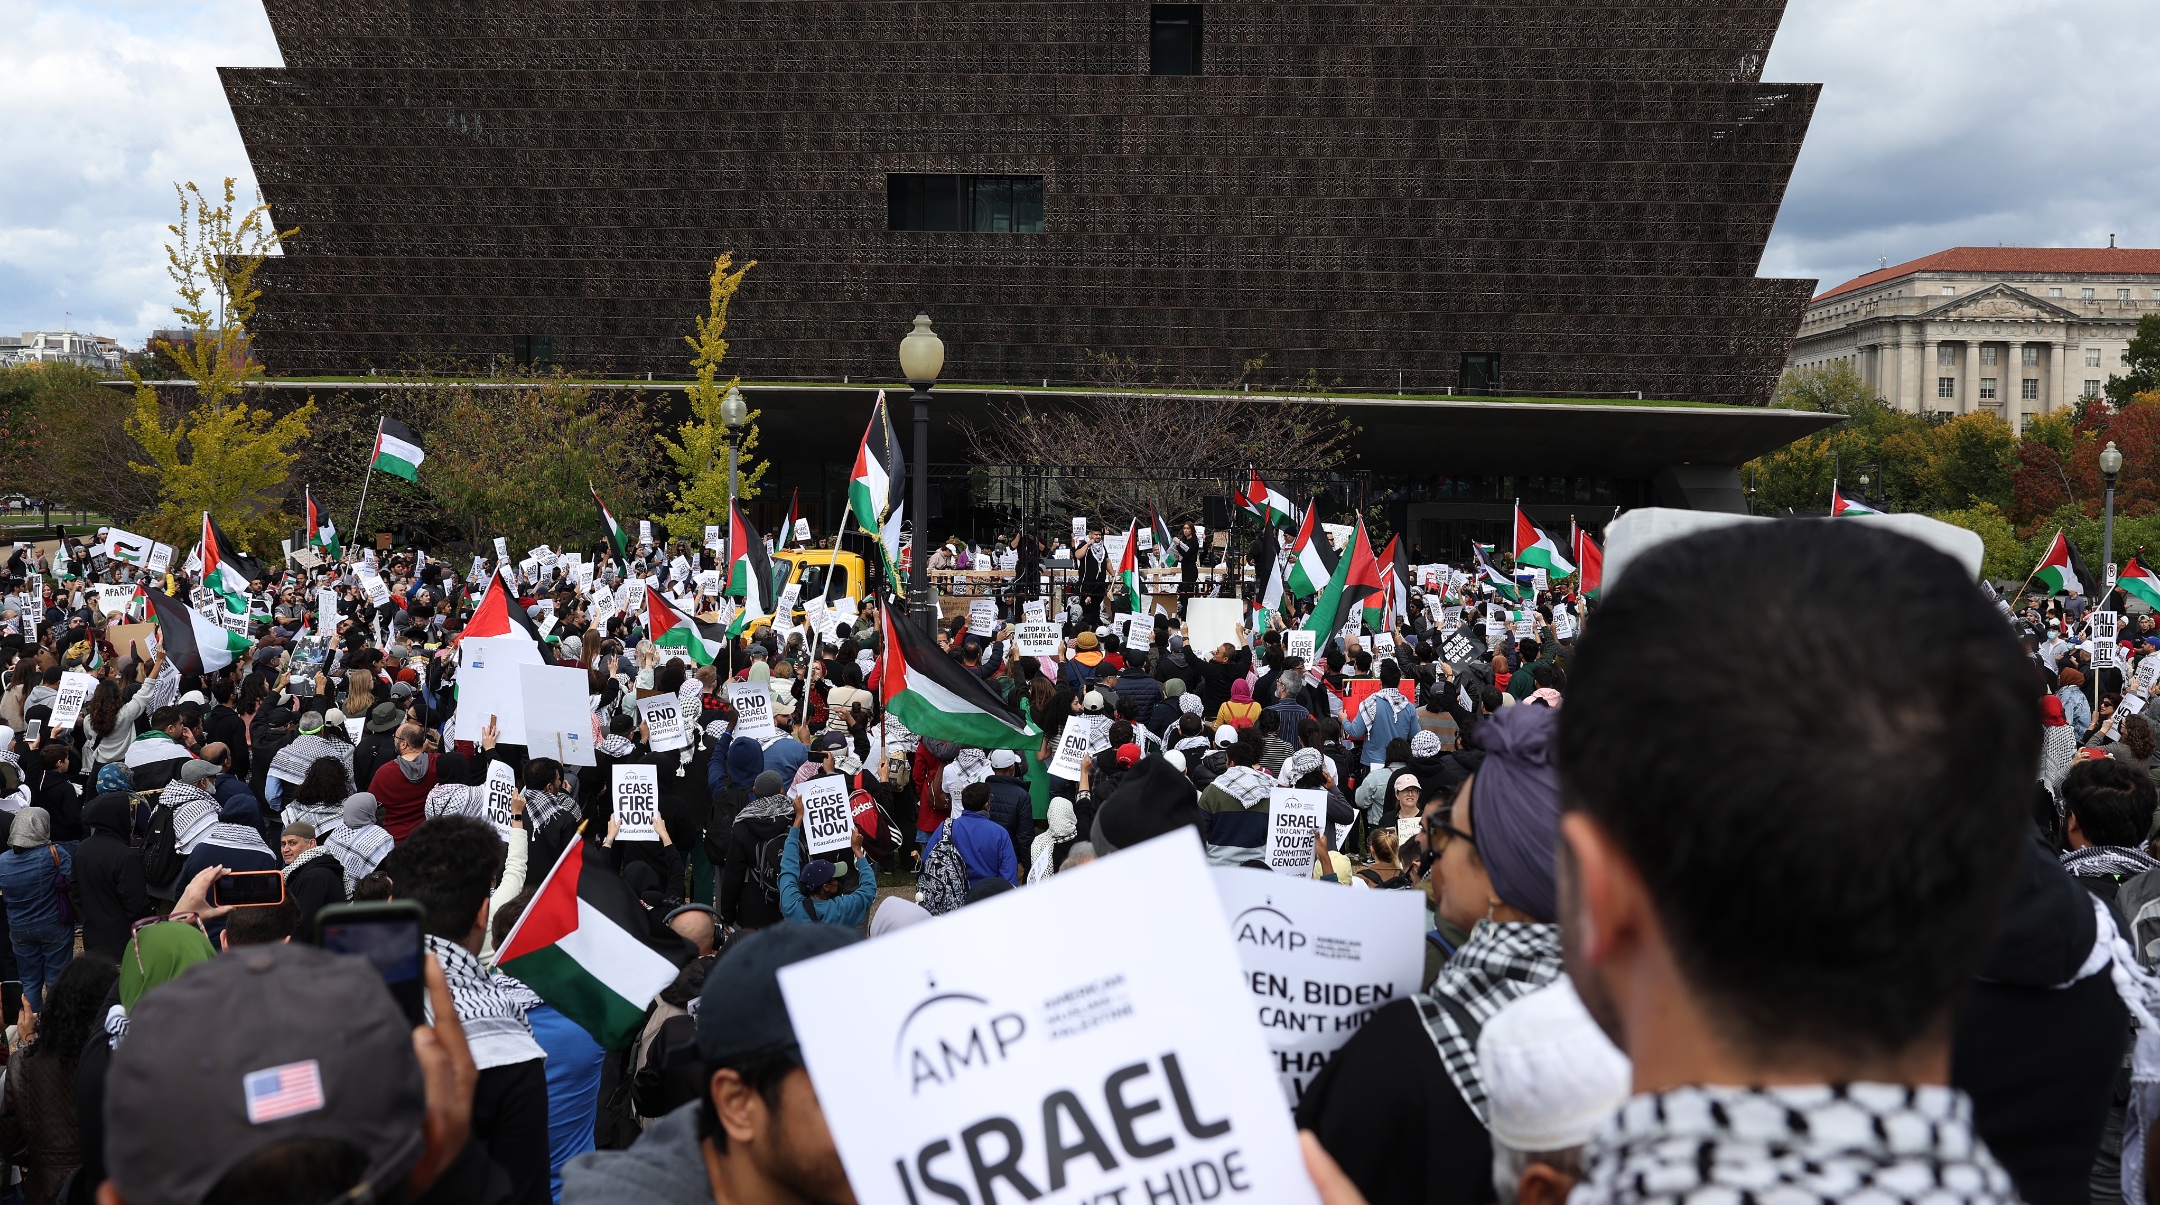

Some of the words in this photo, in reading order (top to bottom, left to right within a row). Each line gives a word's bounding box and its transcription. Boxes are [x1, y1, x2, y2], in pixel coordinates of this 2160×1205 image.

[598, 596, 612, 608] END
[1554, 614, 1566, 622] END
[2100, 626, 2114, 637] AID
[1378, 644, 1392, 653] END
[1443, 642, 1454, 653] END
[1451, 633, 1463, 645] THE
[1444, 637, 1470, 660] BLOCKADE
[1292, 648, 1312, 656] FIRE
[1451, 654, 1461, 663] ON
[1459, 644, 1474, 657] GAZA
[59, 695, 81, 706] HATE
[736, 695, 766, 710] END
[647, 708, 676, 722] END
[739, 707, 767, 718] ISRAELI
[740, 715, 768, 724] APARTHEID
[2118, 707, 2132, 717] ND
[650, 719, 678, 730] ISRAELI
[651, 727, 680, 736] APARTHEID
[1065, 735, 1087, 751] END
[490, 780, 514, 796] CEASE
[618, 783, 653, 794] CEASE
[488, 792, 512, 813] FIRE
[619, 796, 654, 811] FIRE
[806, 793, 843, 809] CEASE
[852, 800, 873, 816] adidas
[488, 808, 512, 827] NOW
[620, 812, 654, 825] NOW
[809, 805, 846, 825] FIRE
[1276, 814, 1320, 828] ISRAEL
[811, 820, 848, 839] NOW
[1275, 836, 1315, 848] YOU'RE
[1272, 857, 1310, 867] GENOCIDE
[1238, 924, 1306, 952] AMP
[1304, 980, 1394, 1006] BIDEN
[1259, 1006, 1328, 1033] CAN'T
[911, 1012, 1026, 1097] AMP
[896, 1051, 1232, 1205] ISRAEL
[1142, 1150, 1250, 1205] HIDE
